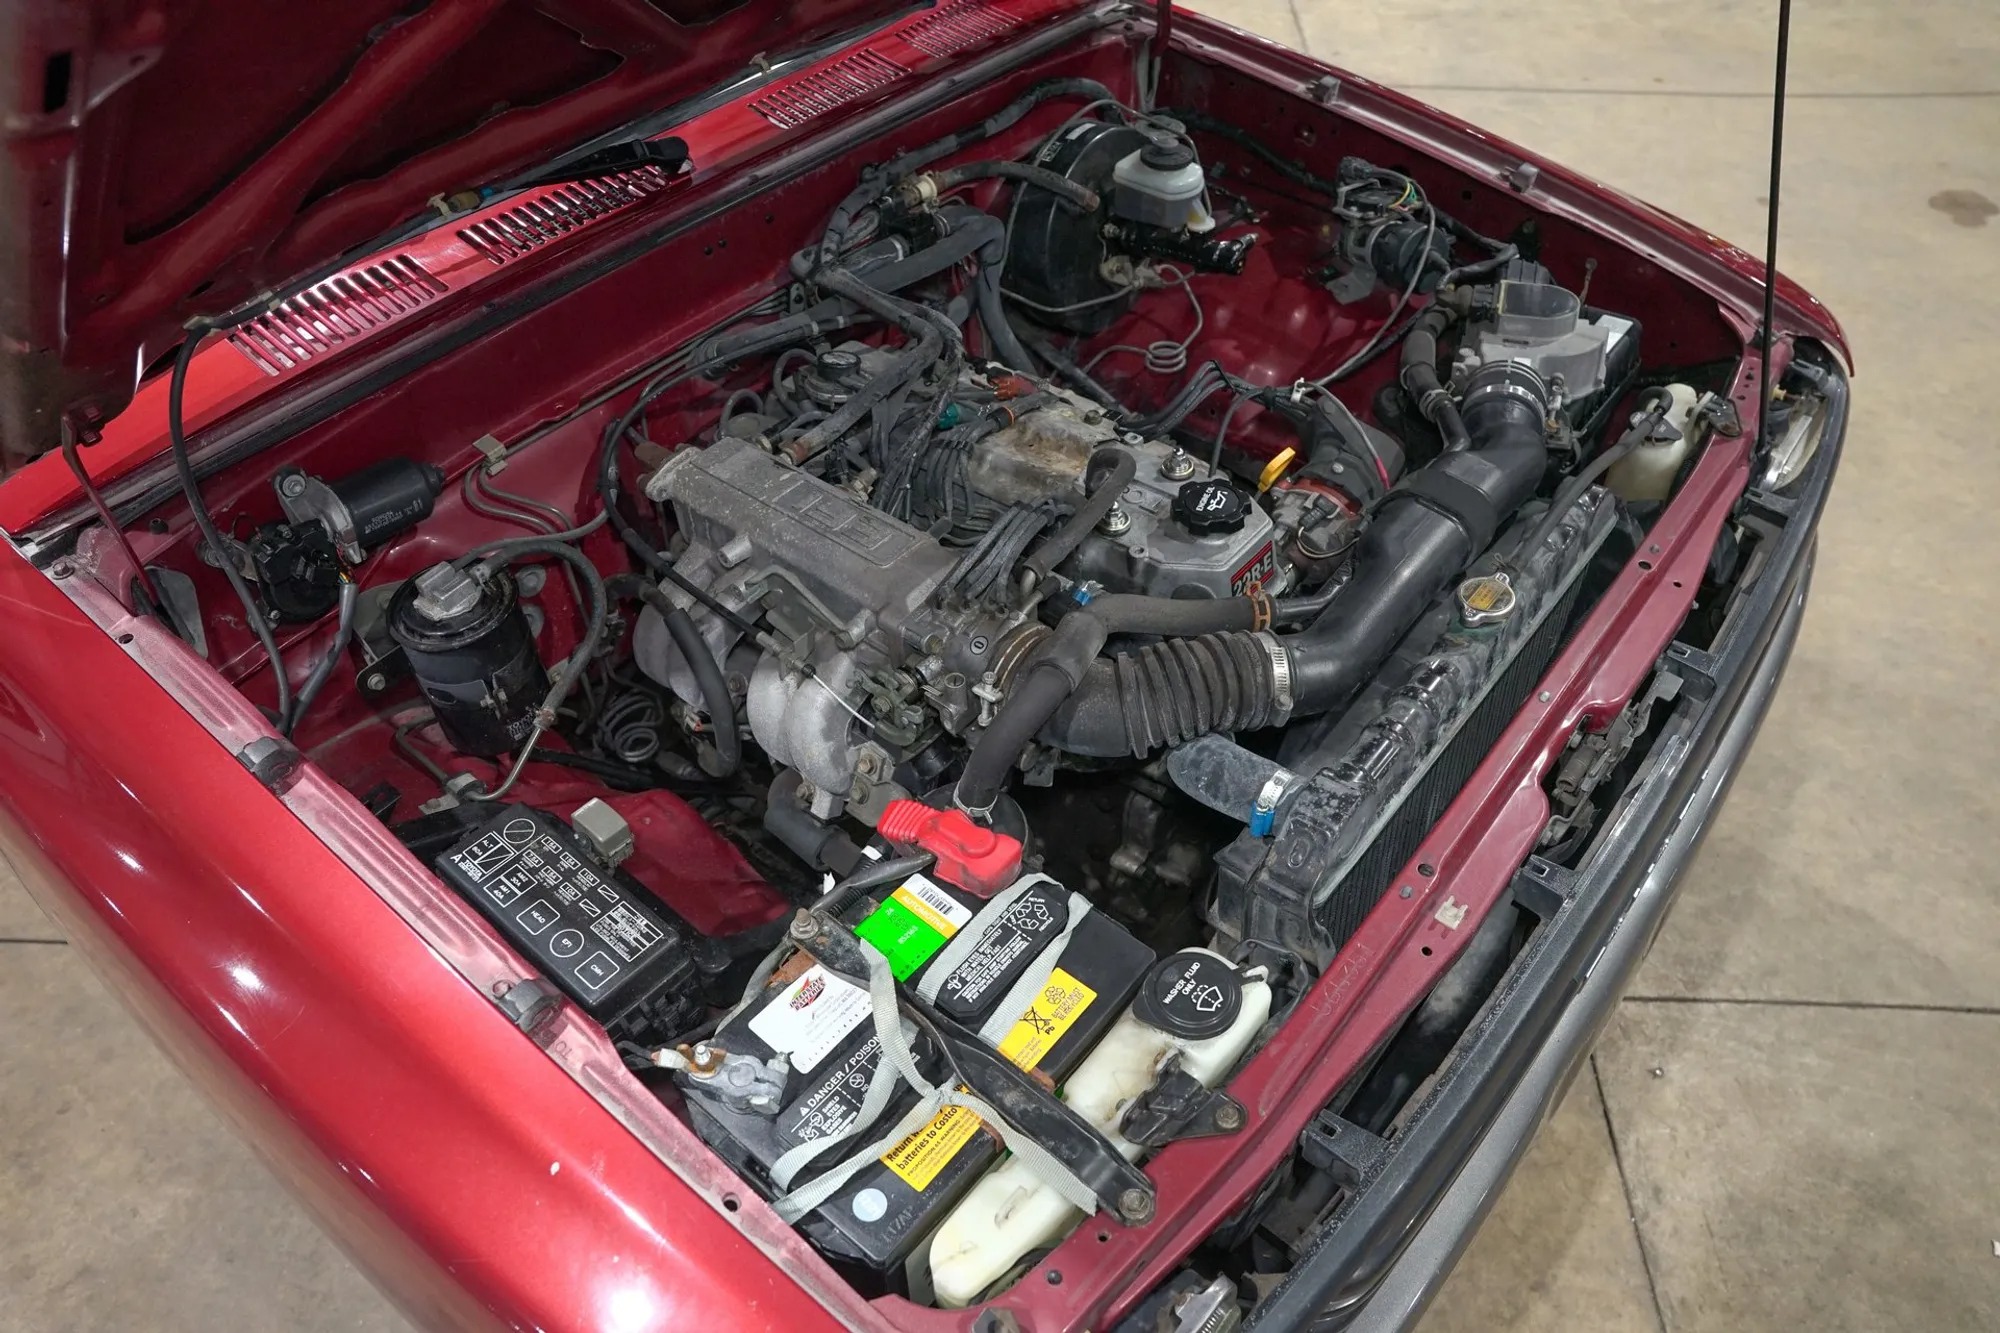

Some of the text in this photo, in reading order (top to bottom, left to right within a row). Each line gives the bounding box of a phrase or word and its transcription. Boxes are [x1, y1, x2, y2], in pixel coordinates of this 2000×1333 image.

[1196, 487, 1215, 511] ENGINE OIL
[482, 837, 493, 848] ALT
[450, 854, 463, 863] A
[462, 859, 482, 877] TOYOTA
[510, 877, 521, 887] 30A
[516, 872, 528, 882] AM2
[584, 872, 595, 882] 10A
[493, 890, 504, 899] 40A
[499, 885, 510, 894] AM1
[565, 886, 576, 896] 10A
[531, 910, 546, 924] HEAD
[900, 894, 946, 930] AUTOMOTIVE
[562, 938, 572, 948] EFI
[956, 929, 1003, 975] FLUSH EYES IMMEDIATELY
[590, 964, 604, 976] CMH
[961, 967, 972, 978] WITH
[984, 945, 993, 954] GET
[965, 944, 1001, 982] MEDICAL HELP FAST
[1162, 962, 1201, 1004] WASHER FLUID
[1181, 978, 1197, 995] ONLY
[787, 976, 825, 1008] INTERSTATE
[792, 981, 828, 1011] BATTERIES
[1050, 986, 1081, 1018] BATTERY MUST
[1057, 991, 1085, 1020] BE RECYCLED
[1044, 1026, 1055, 1035] Pb
[806, 1071, 847, 1108] DANGER
[822, 1096, 840, 1113] SHIELD
[825, 1104, 840, 1117] EYES
[819, 1105, 847, 1131] EXPLOSIVE
[824, 1117, 843, 1134] GASES
[894, 1135, 931, 1171] batteries
[925, 1127, 937, 1140] to
[932, 1105, 959, 1131] Costco
[885, 1134, 914, 1162] Return
[905, 1146, 937, 1176] PROPOSITION
